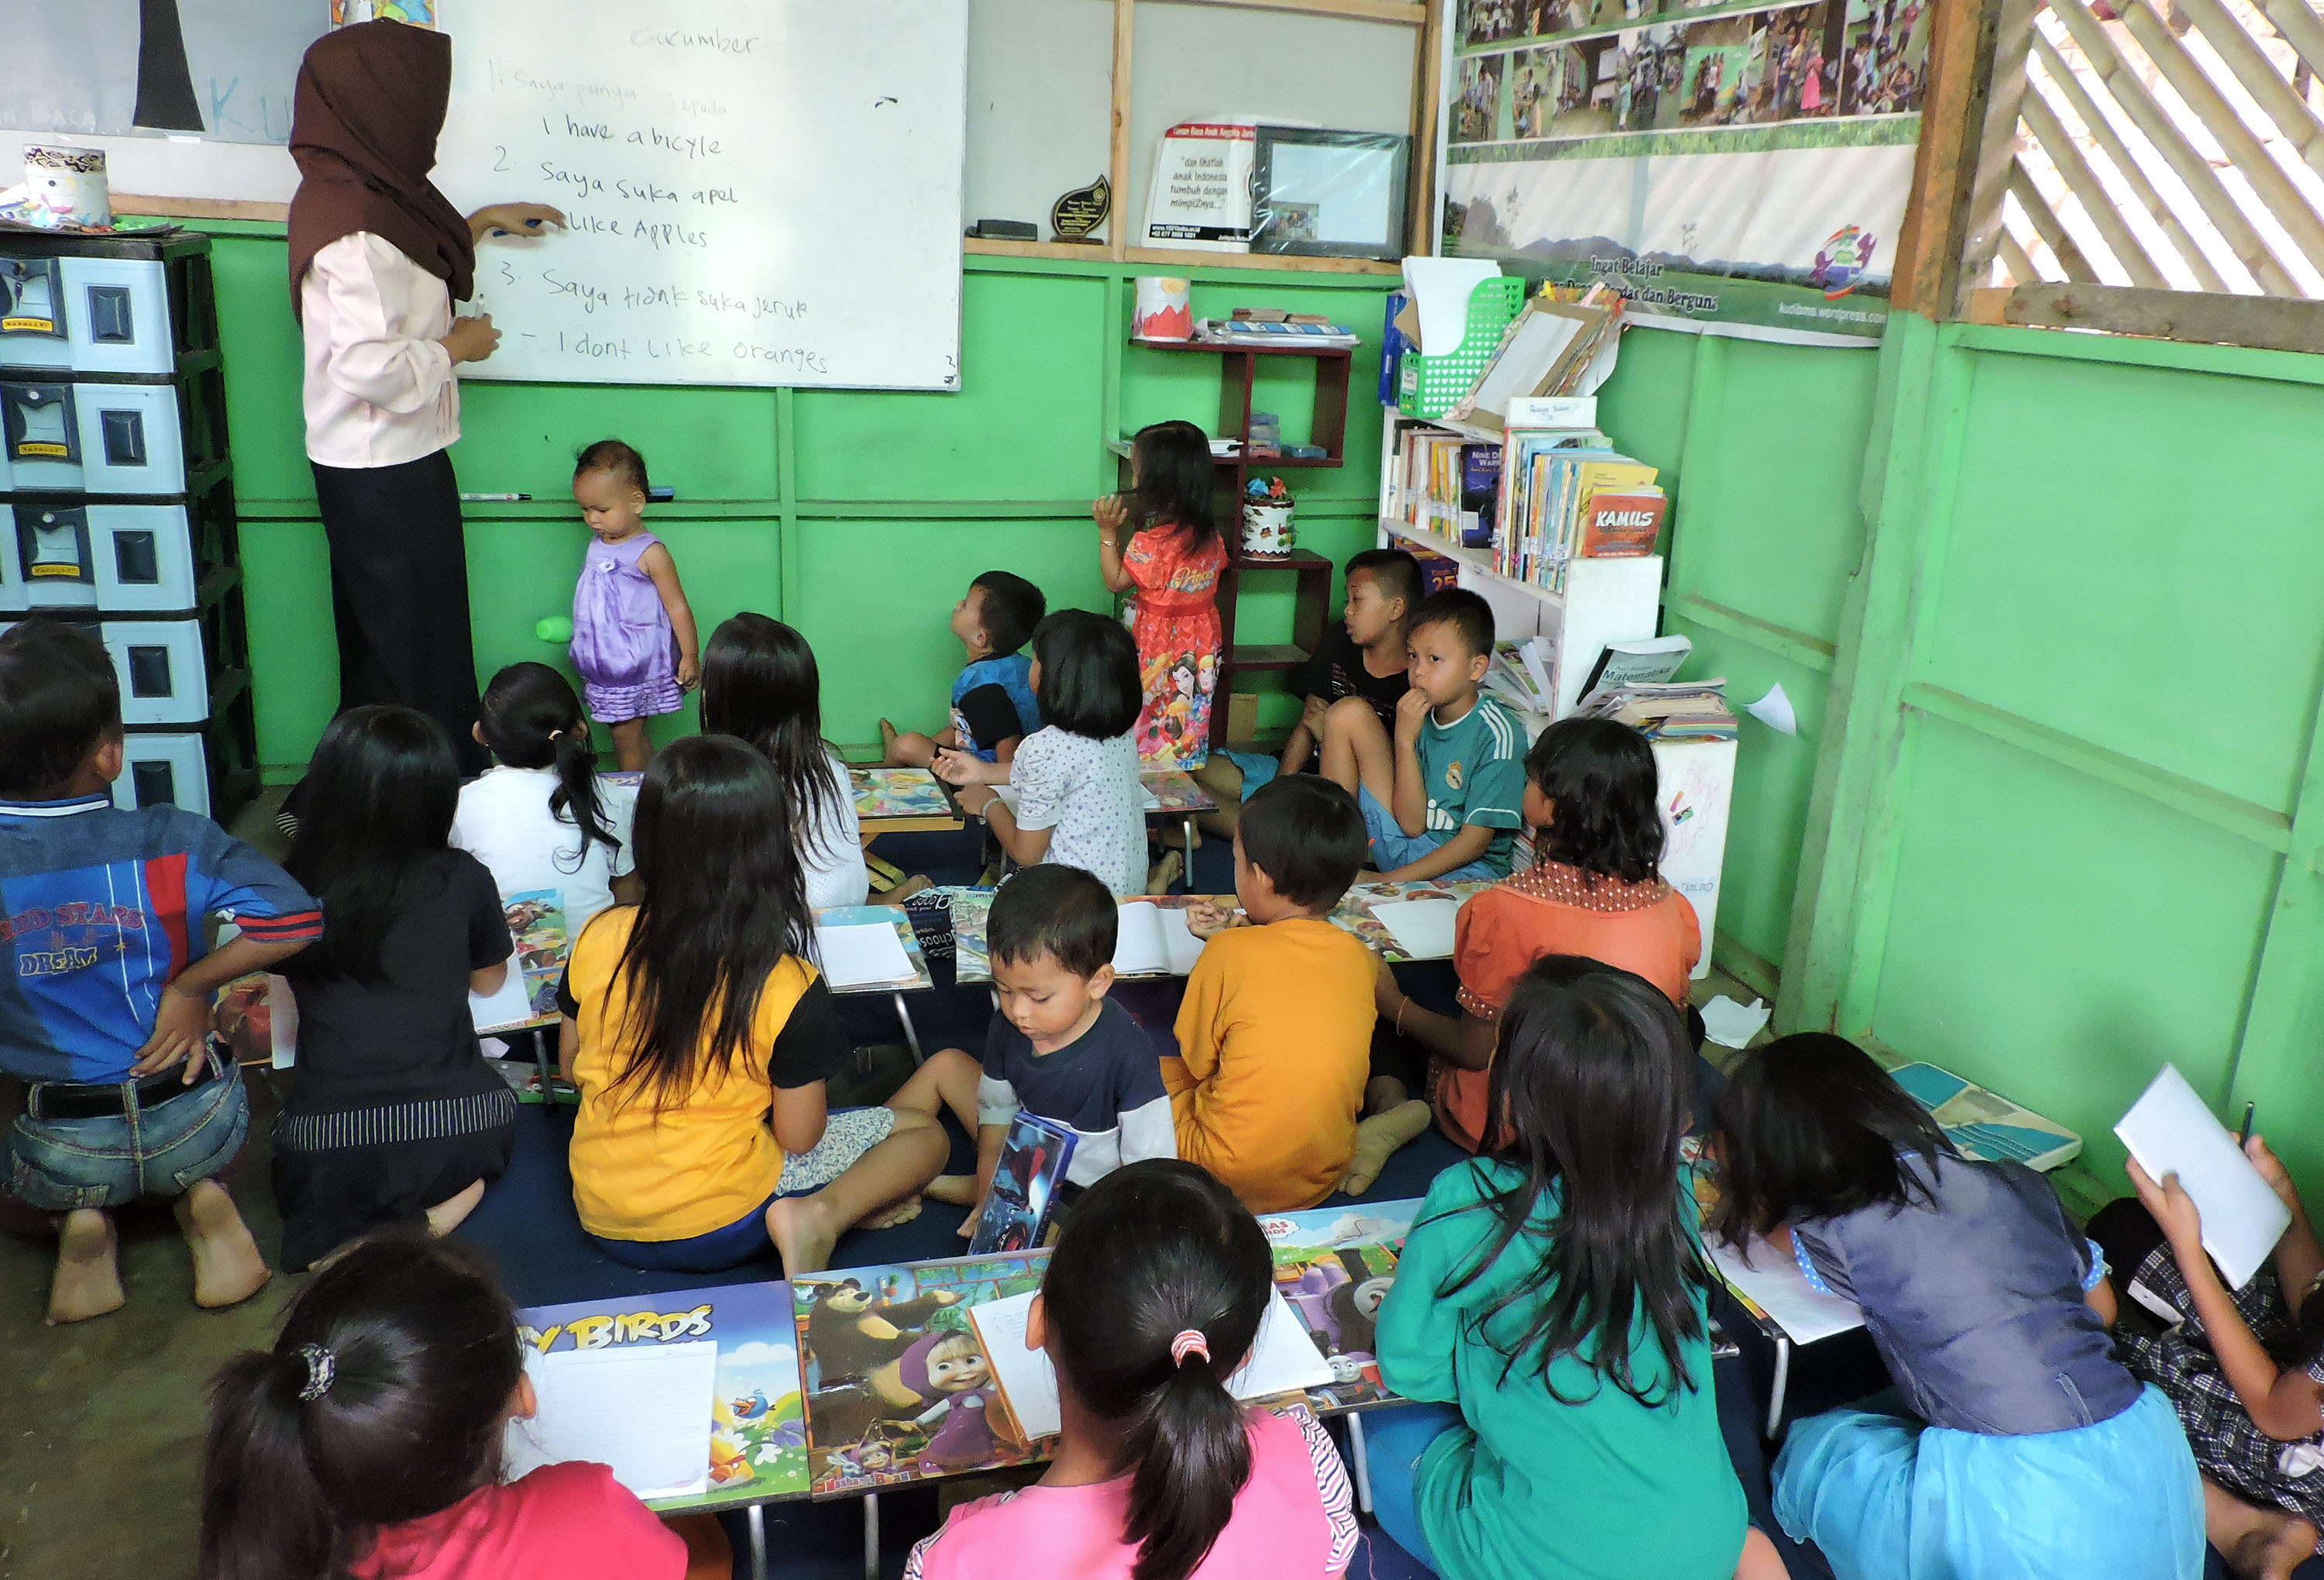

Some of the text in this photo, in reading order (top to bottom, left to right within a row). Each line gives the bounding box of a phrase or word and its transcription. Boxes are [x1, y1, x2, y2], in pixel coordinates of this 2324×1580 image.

[566, 113, 614, 140] have
[651, 127, 724, 160] bicyle
[541, 161, 604, 198] Saya
[692, 187, 739, 205] apel
[634, 219, 708, 249] Apples
[1590, 254, 1664, 280] Ingat Belajar
[542, 269, 608, 314] Saya
[1642, 285, 1665, 303] dan
[576, 336, 631, 359] dont
[732, 340, 828, 373] oranges
[1596, 510, 1655, 527] KAMUS
[1602, 666, 1672, 682] Matematika
[55, 901, 143, 930] STARS
[19, 946, 98, 976] DREAM
[566, 1303, 713, 1351] BIRDS
